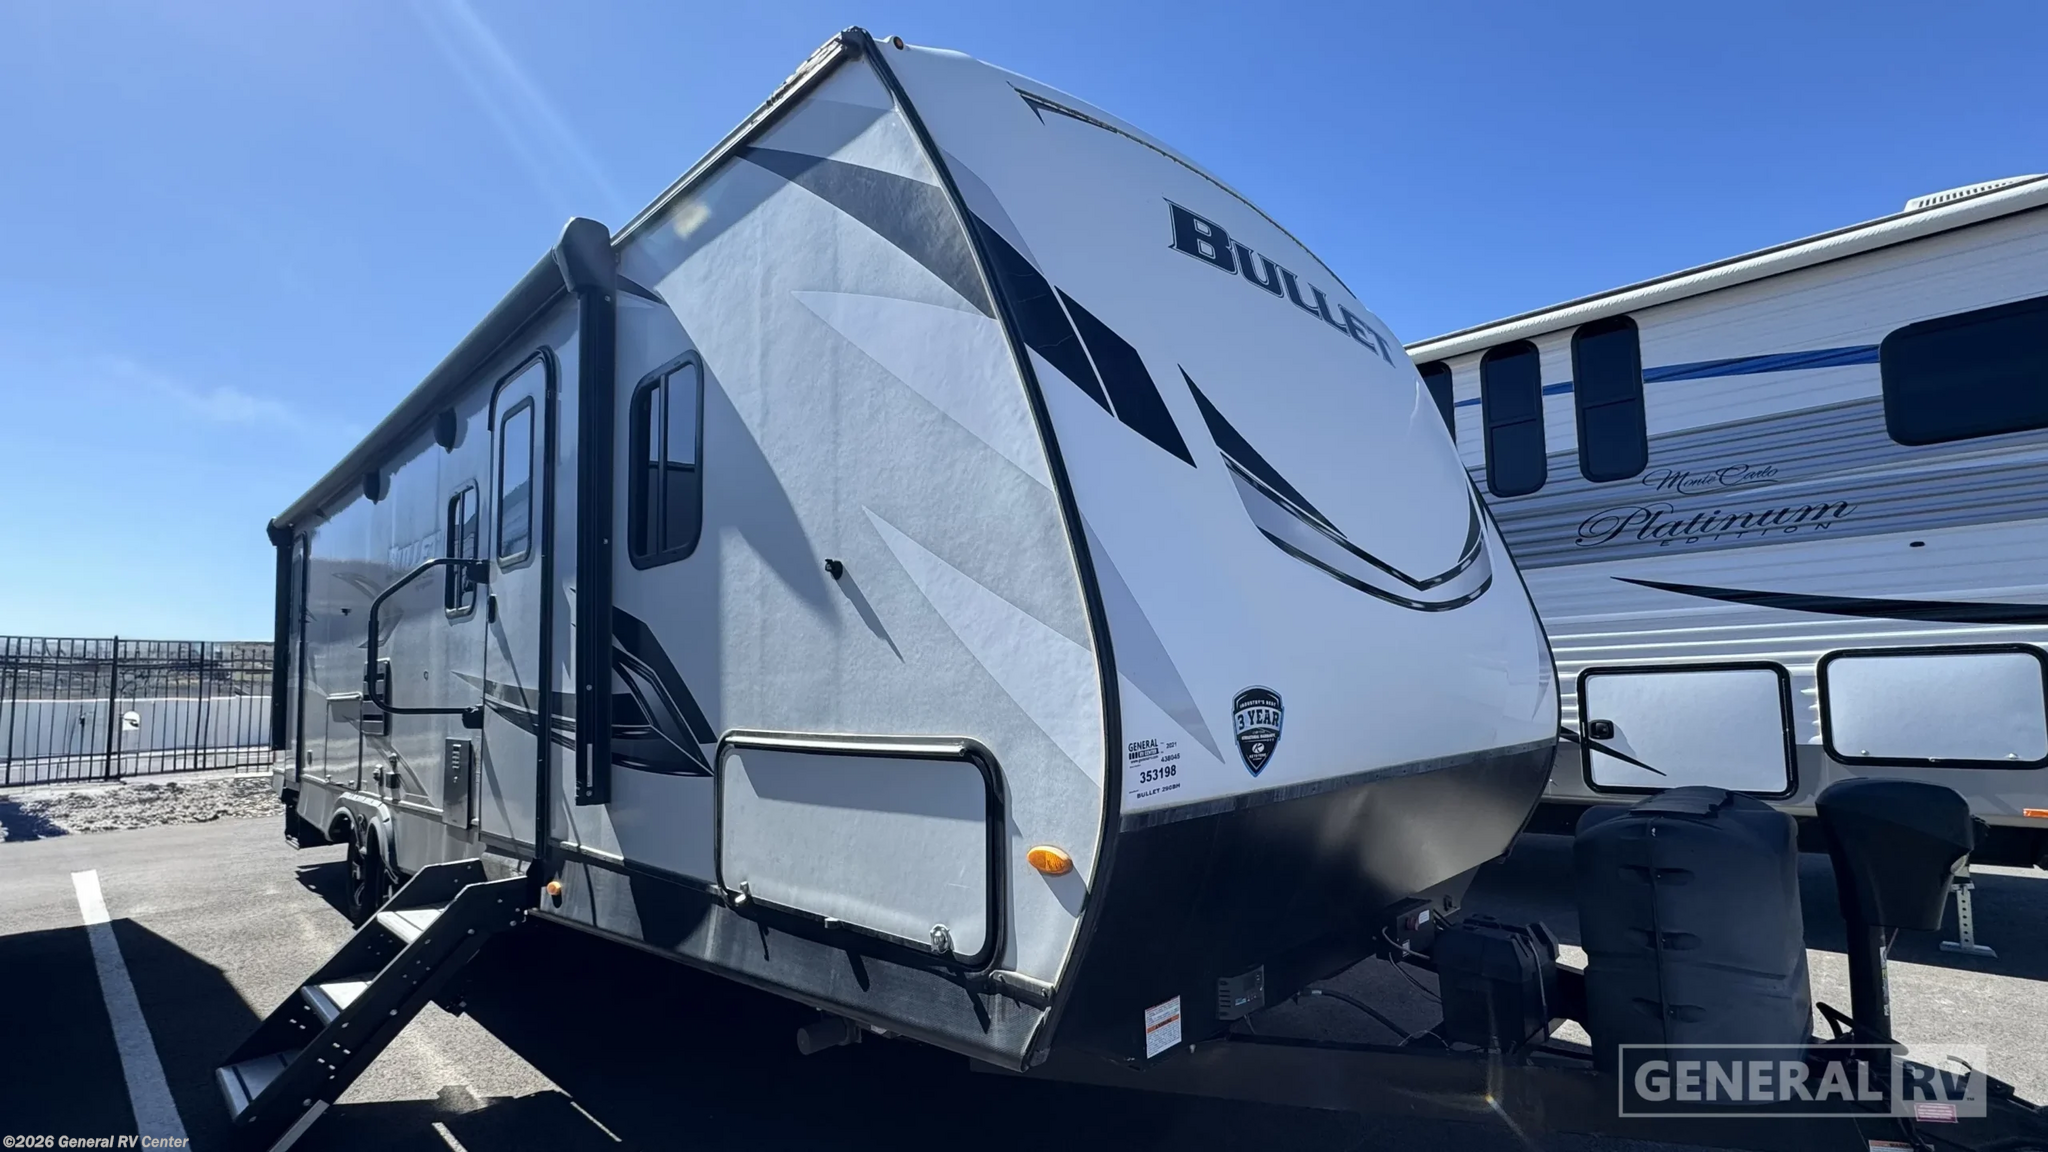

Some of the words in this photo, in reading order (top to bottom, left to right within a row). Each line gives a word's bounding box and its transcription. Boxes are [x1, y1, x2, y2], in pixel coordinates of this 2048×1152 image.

[1162, 197, 1396, 369] BULLET
[1642, 467, 1716, 495] Monte
[1715, 463, 1779, 485] Carlo
[1574, 500, 1857, 547] Platinum
[1659, 522, 1831, 547] EDITION
[1237, 714, 1245, 730] 3
[1247, 708, 1279, 727] YEAR
[1128, 738, 1158, 752] GENERAL
[1139, 764, 1177, 784] 353198
[1136, 787, 1161, 799] BULLET
